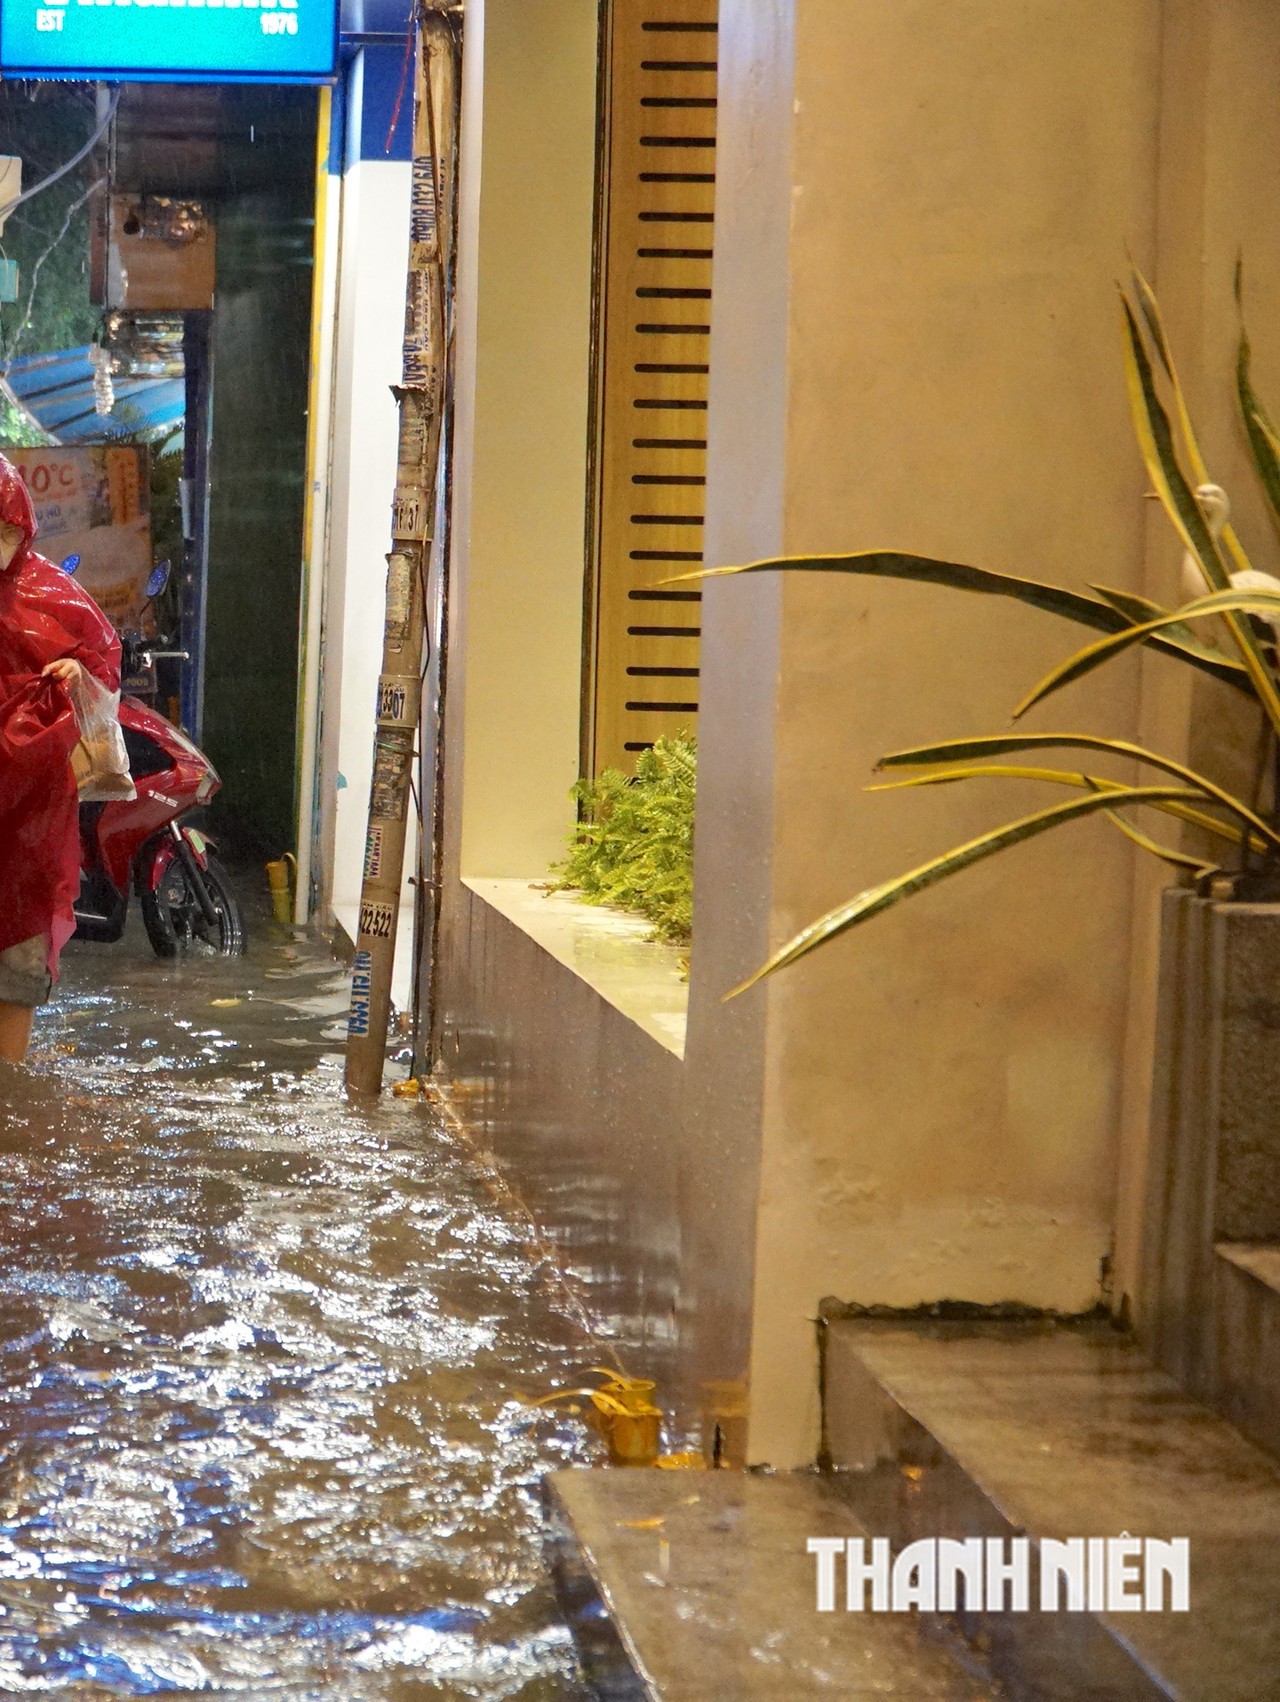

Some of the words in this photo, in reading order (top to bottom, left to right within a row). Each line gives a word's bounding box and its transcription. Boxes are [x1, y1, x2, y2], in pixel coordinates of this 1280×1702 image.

[36, 9, 65, 31] EST
[260, 12, 298, 35] 1976
[148, 789, 179, 808] 125
